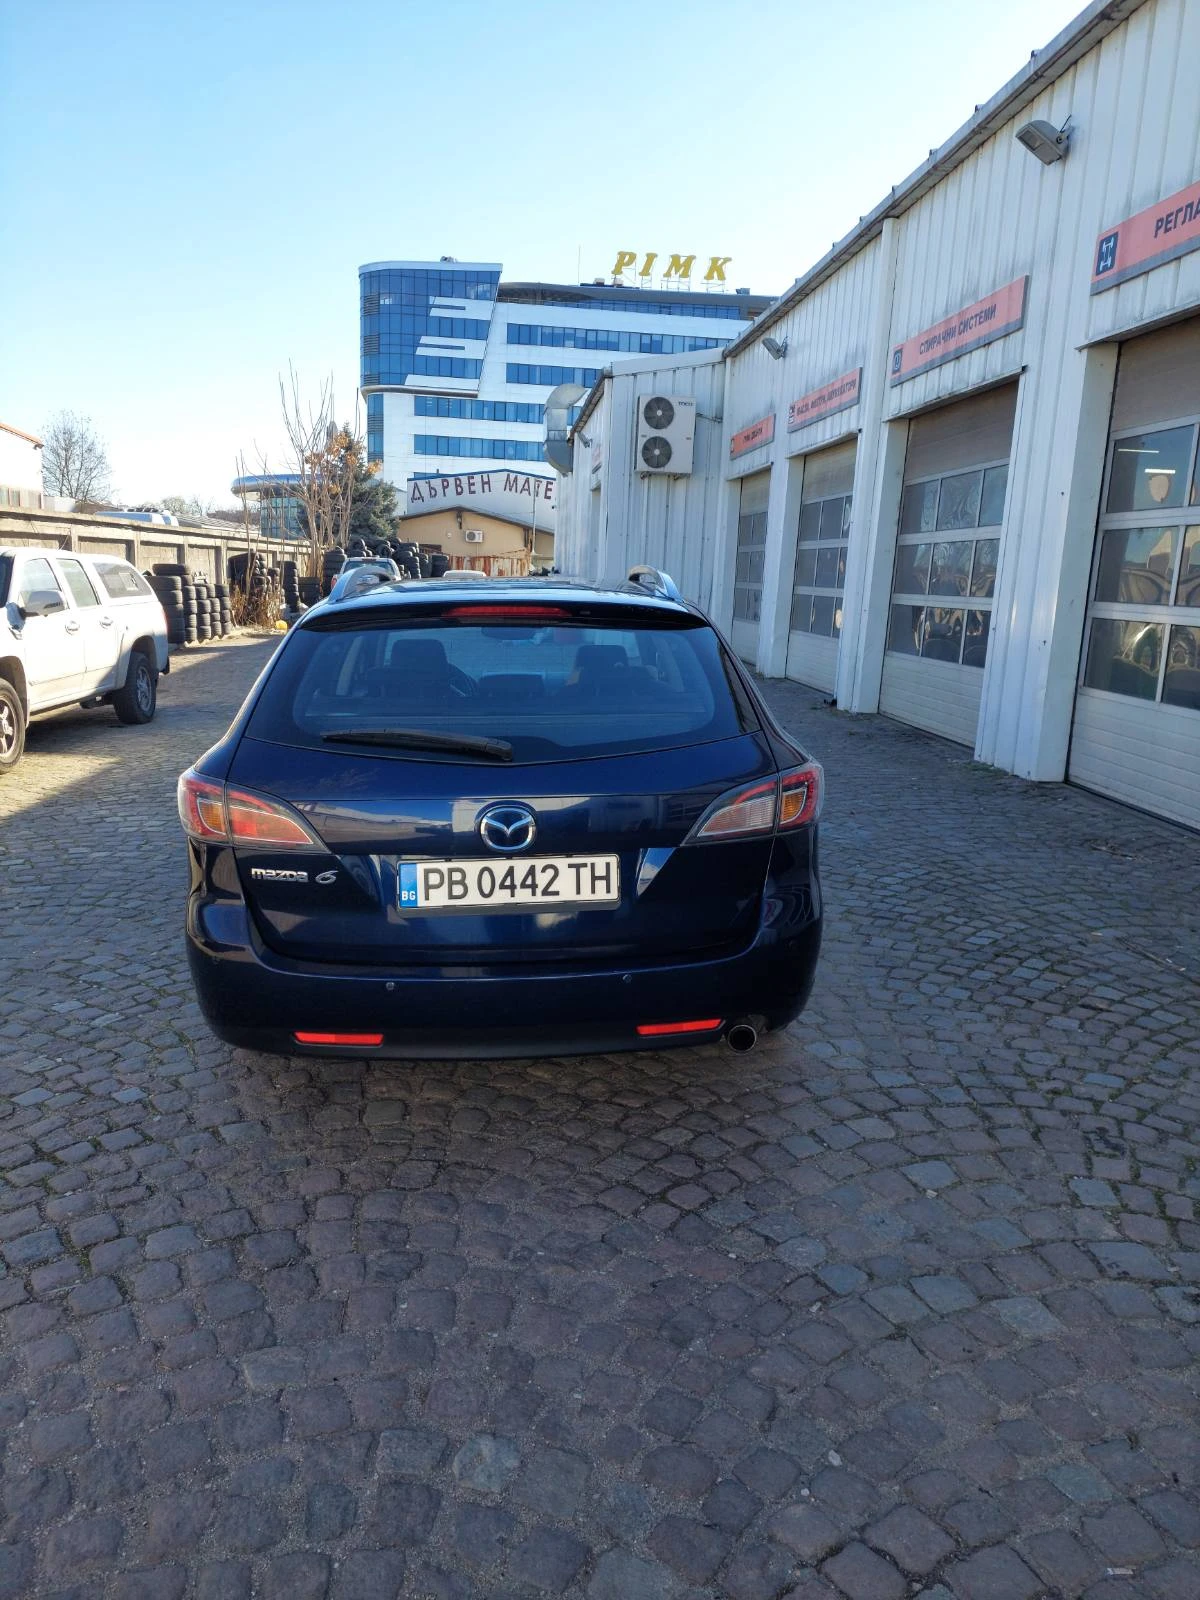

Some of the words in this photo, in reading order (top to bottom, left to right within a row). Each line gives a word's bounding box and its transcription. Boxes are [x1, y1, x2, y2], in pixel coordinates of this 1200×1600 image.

[611, 251, 733, 280] PIMK
[919, 325, 957, 355] СПИРАЧНИ
[958, 303, 997, 336] СИСТЕМИ
[411, 474, 492, 503] ДЪРВЕН
[315, 870, 339, 884] 6
[423, 867, 469, 901] PB
[477, 864, 560, 899] 0442
[567, 862, 611, 896] TH
[401, 891, 416, 901] BG
